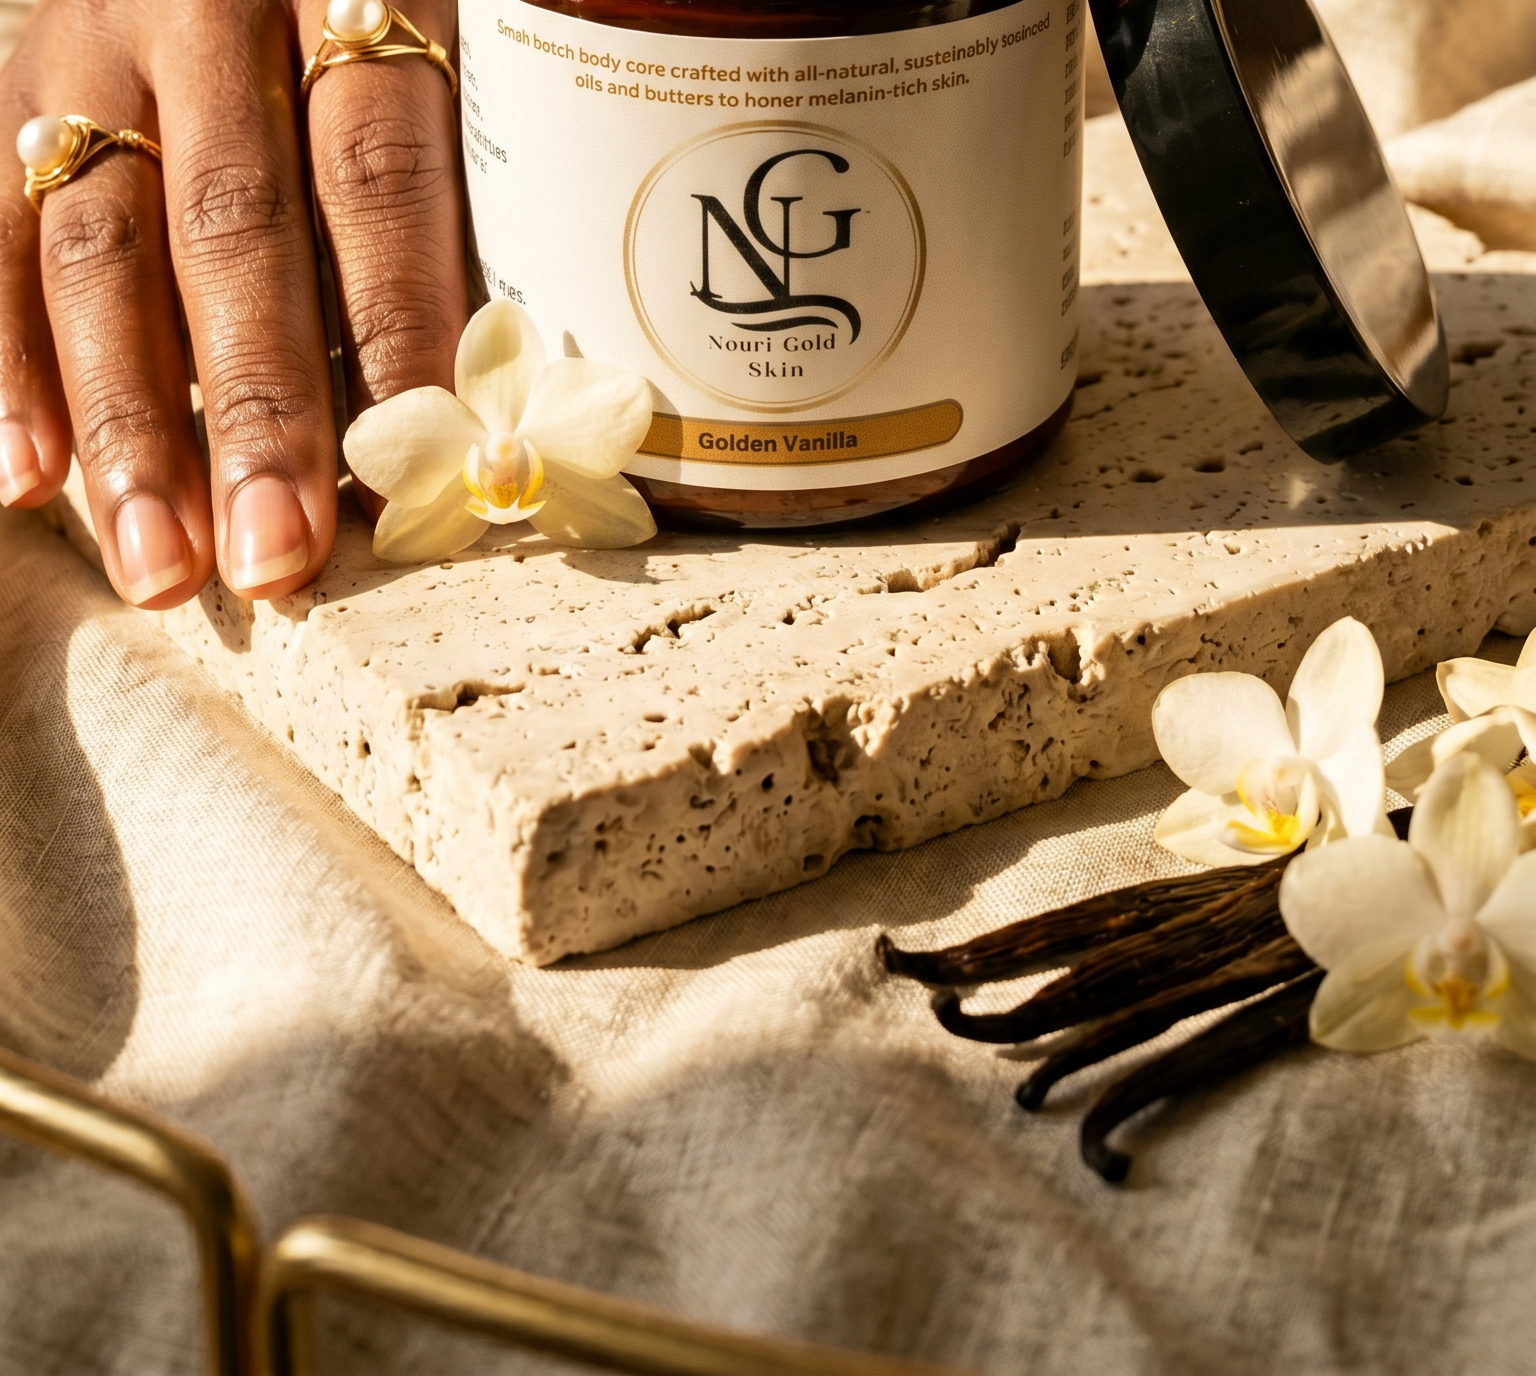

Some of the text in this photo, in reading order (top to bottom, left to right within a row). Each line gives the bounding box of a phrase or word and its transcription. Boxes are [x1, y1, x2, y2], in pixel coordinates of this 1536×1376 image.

[533, 33, 575, 61] botch
[579, 47, 621, 73] body
[625, 59, 666, 78] core
[669, 64, 741, 83] crafted
[746, 66, 790, 83] with
[794, 57, 900, 83] all-natural,
[574, 74, 603, 93] oils
[607, 82, 640, 99] and
[644, 84, 714, 107] butters
[718, 91, 740, 108] to
[744, 92, 804, 109] honer
[931, 70, 970, 92] skin.
[708, 332, 836, 353] Nouri Gold
[748, 360, 805, 378] Skin
[697, 430, 859, 453] Golden Vanilla
